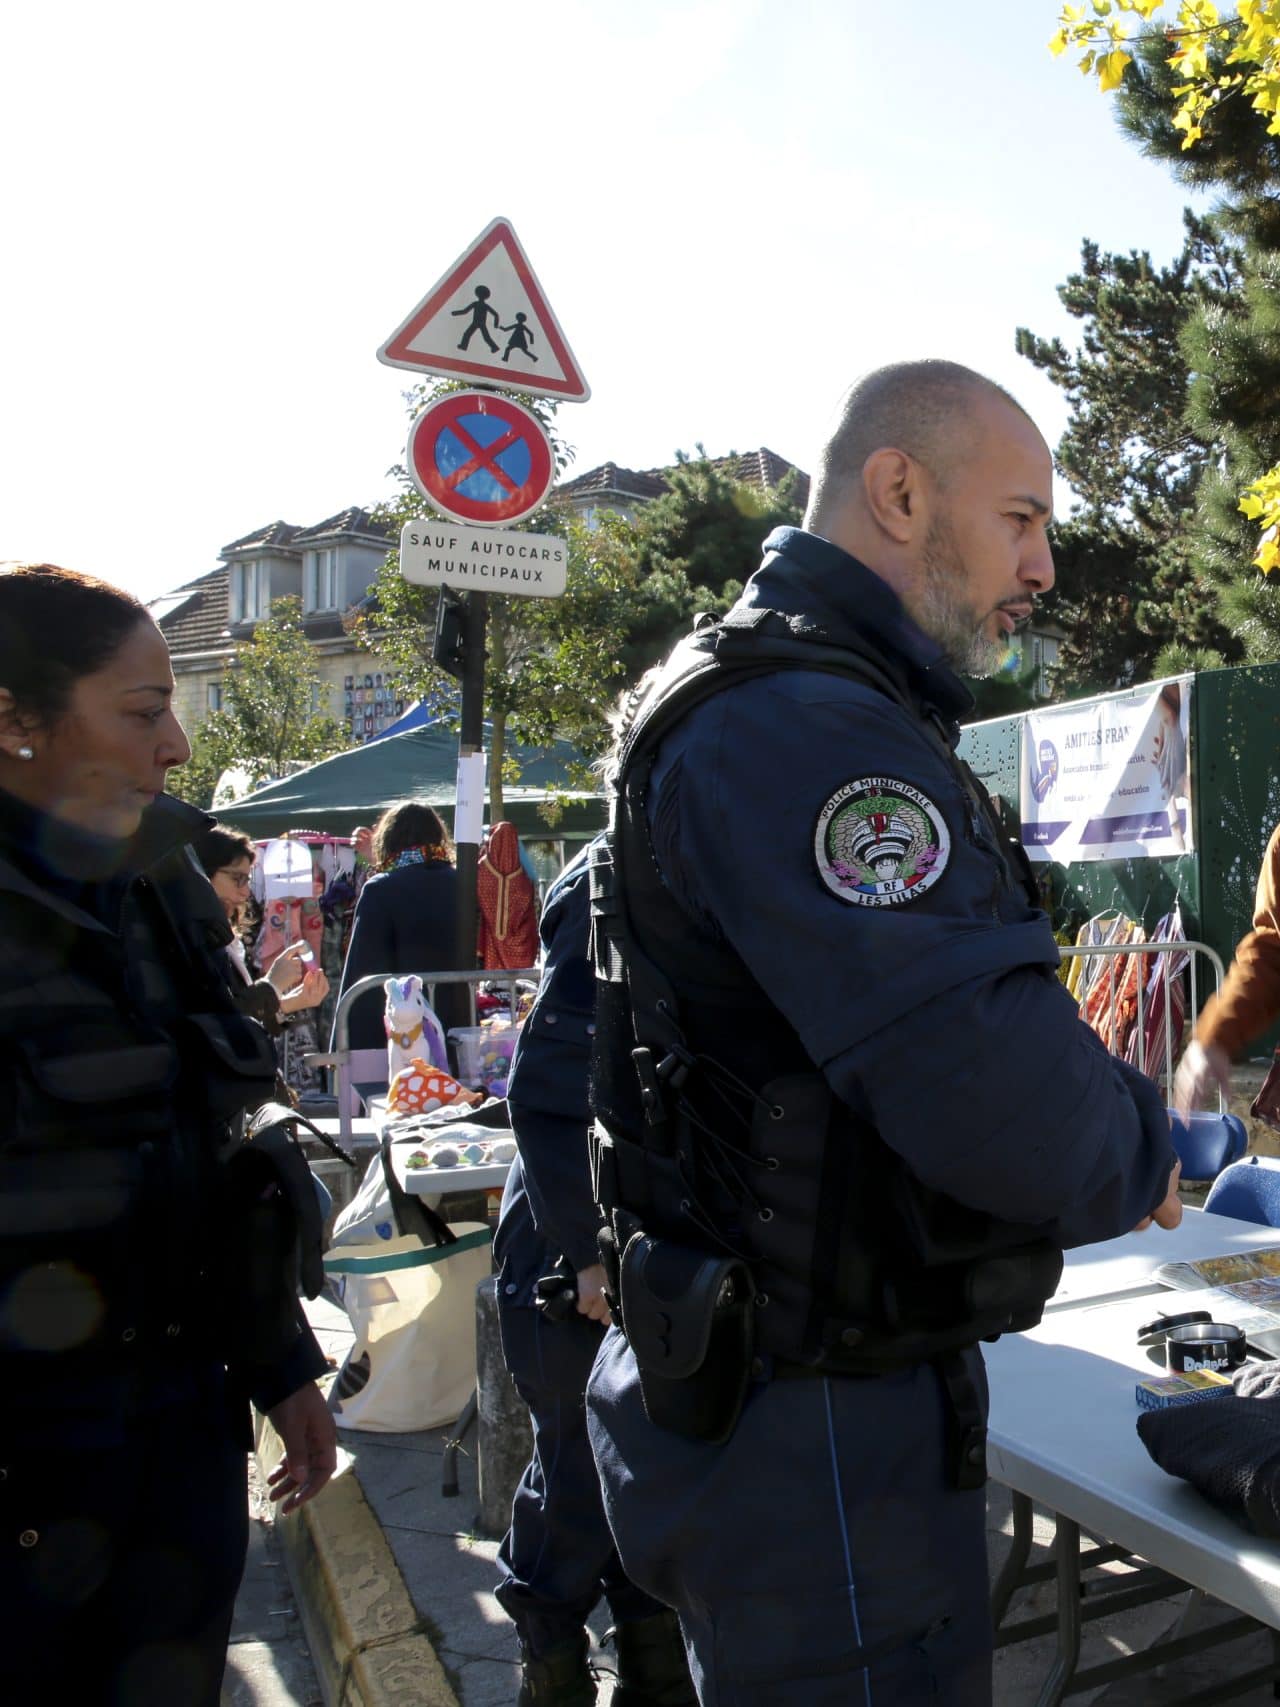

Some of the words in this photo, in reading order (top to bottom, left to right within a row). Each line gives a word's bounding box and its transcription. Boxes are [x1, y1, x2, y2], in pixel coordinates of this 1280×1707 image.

[410, 532, 458, 550] SAUF
[471, 540, 564, 563] AUTOCARS
[427, 558, 544, 583] MUNICIPAUX
[821, 783, 857, 819] POLICE
[859, 778, 932, 810] MUNICIPALE
[858, 894, 883, 906] LES
[889, 882, 928, 904] LILAS
[883, 881, 897, 892] RF
